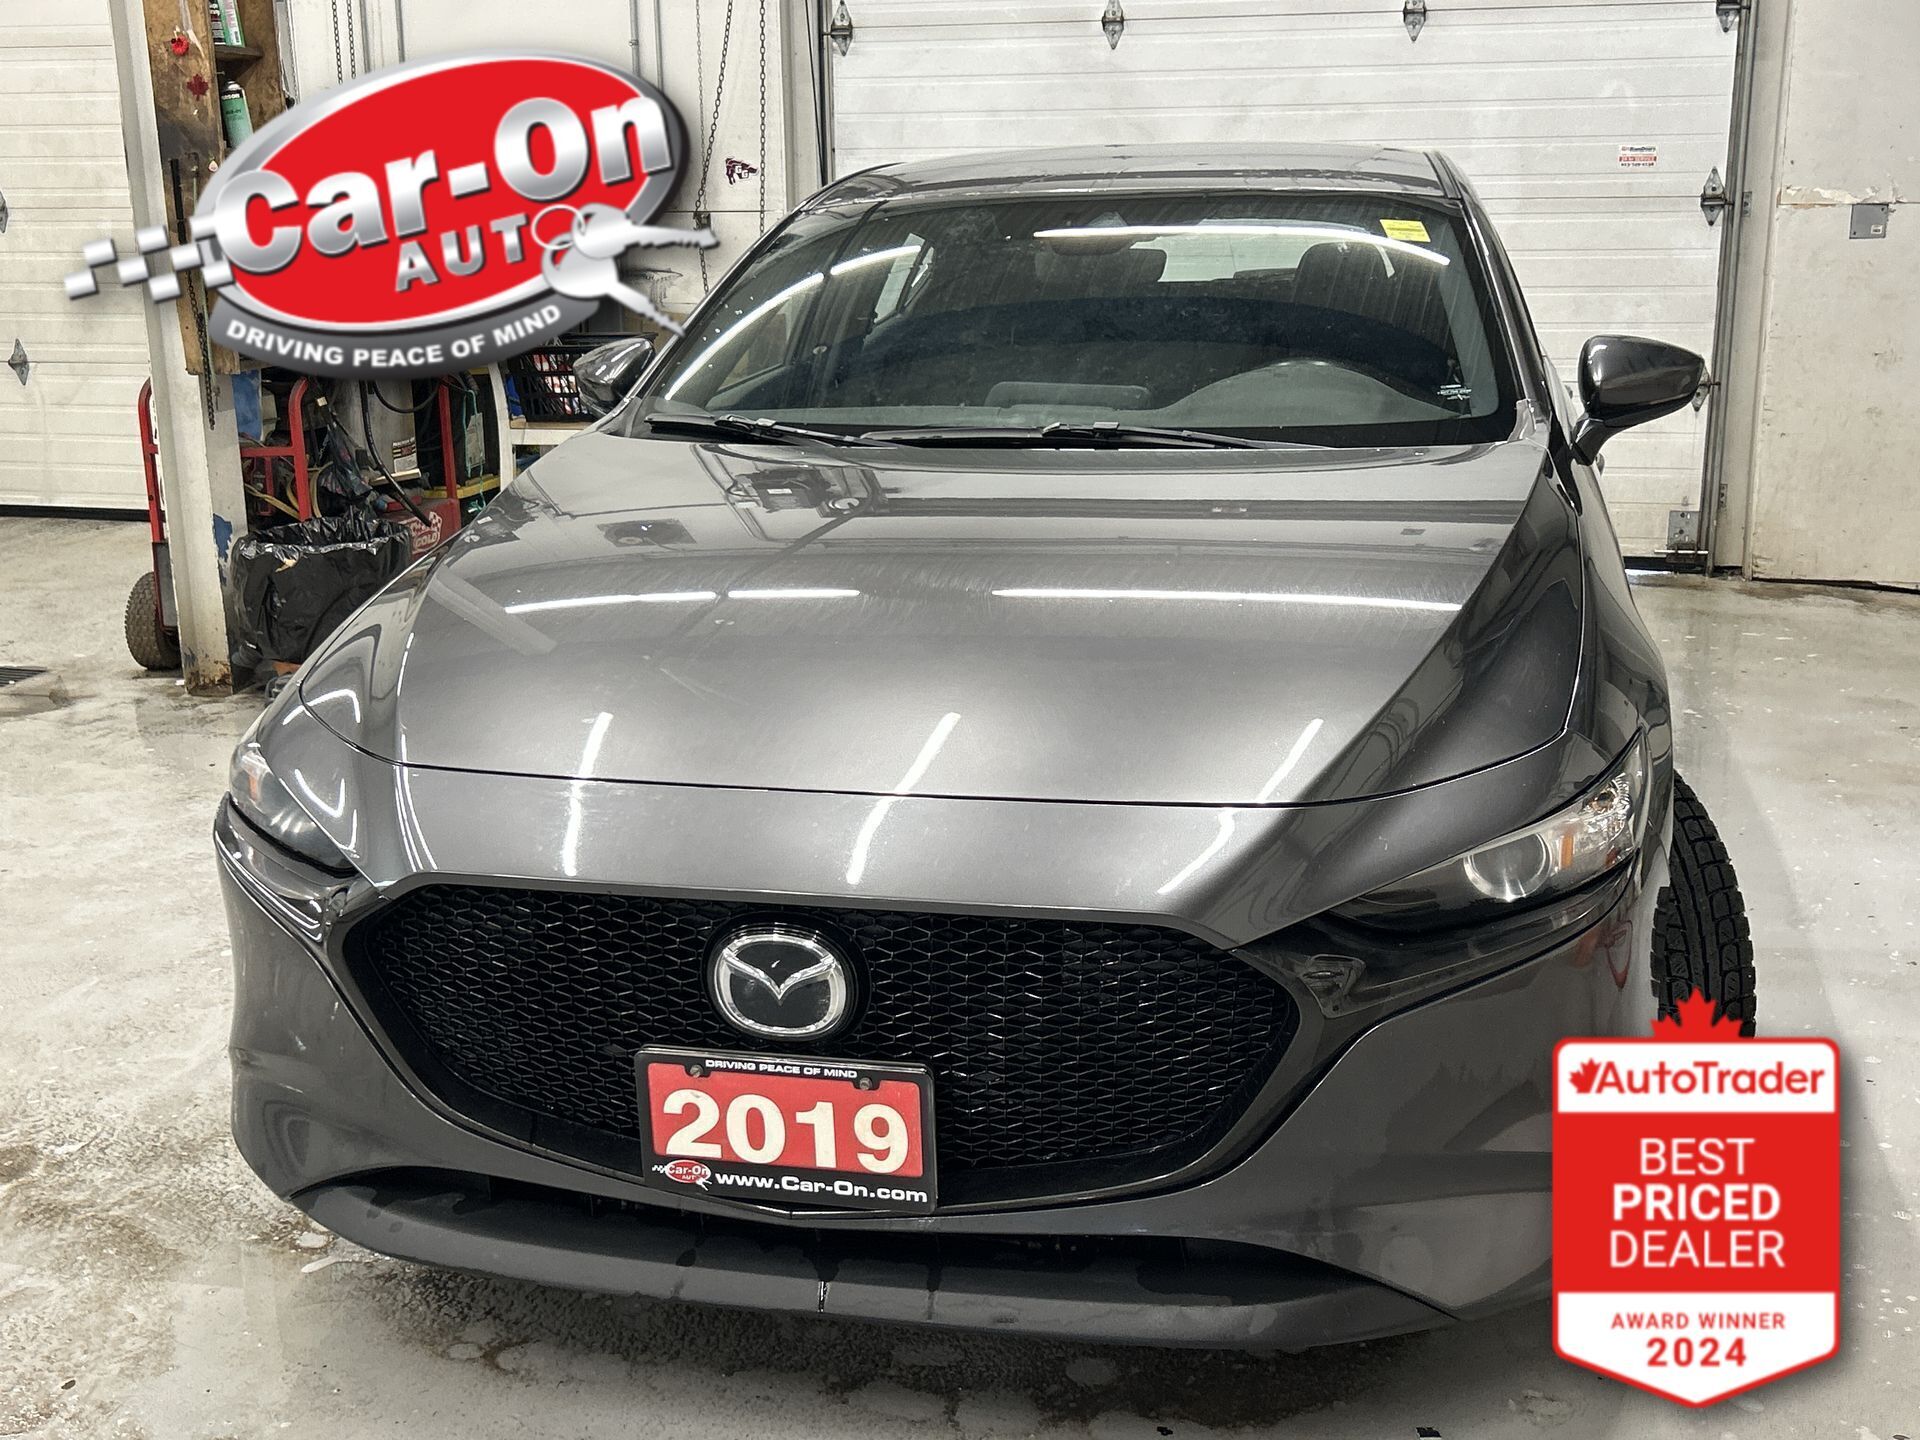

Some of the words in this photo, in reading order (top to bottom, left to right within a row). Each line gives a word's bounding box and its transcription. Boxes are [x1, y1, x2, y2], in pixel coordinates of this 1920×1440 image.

[705, 1059, 756, 1071] DRIVING
[759, 1062, 801, 1075] PEACE
[803, 1067, 821, 1076] OF
[824, 1068, 858, 1079] MIND
[663, 1089, 909, 1174] 2019
[667, 1164, 709, 1177] Car-On
[715, 1172, 928, 1203] www.Car-On.com
